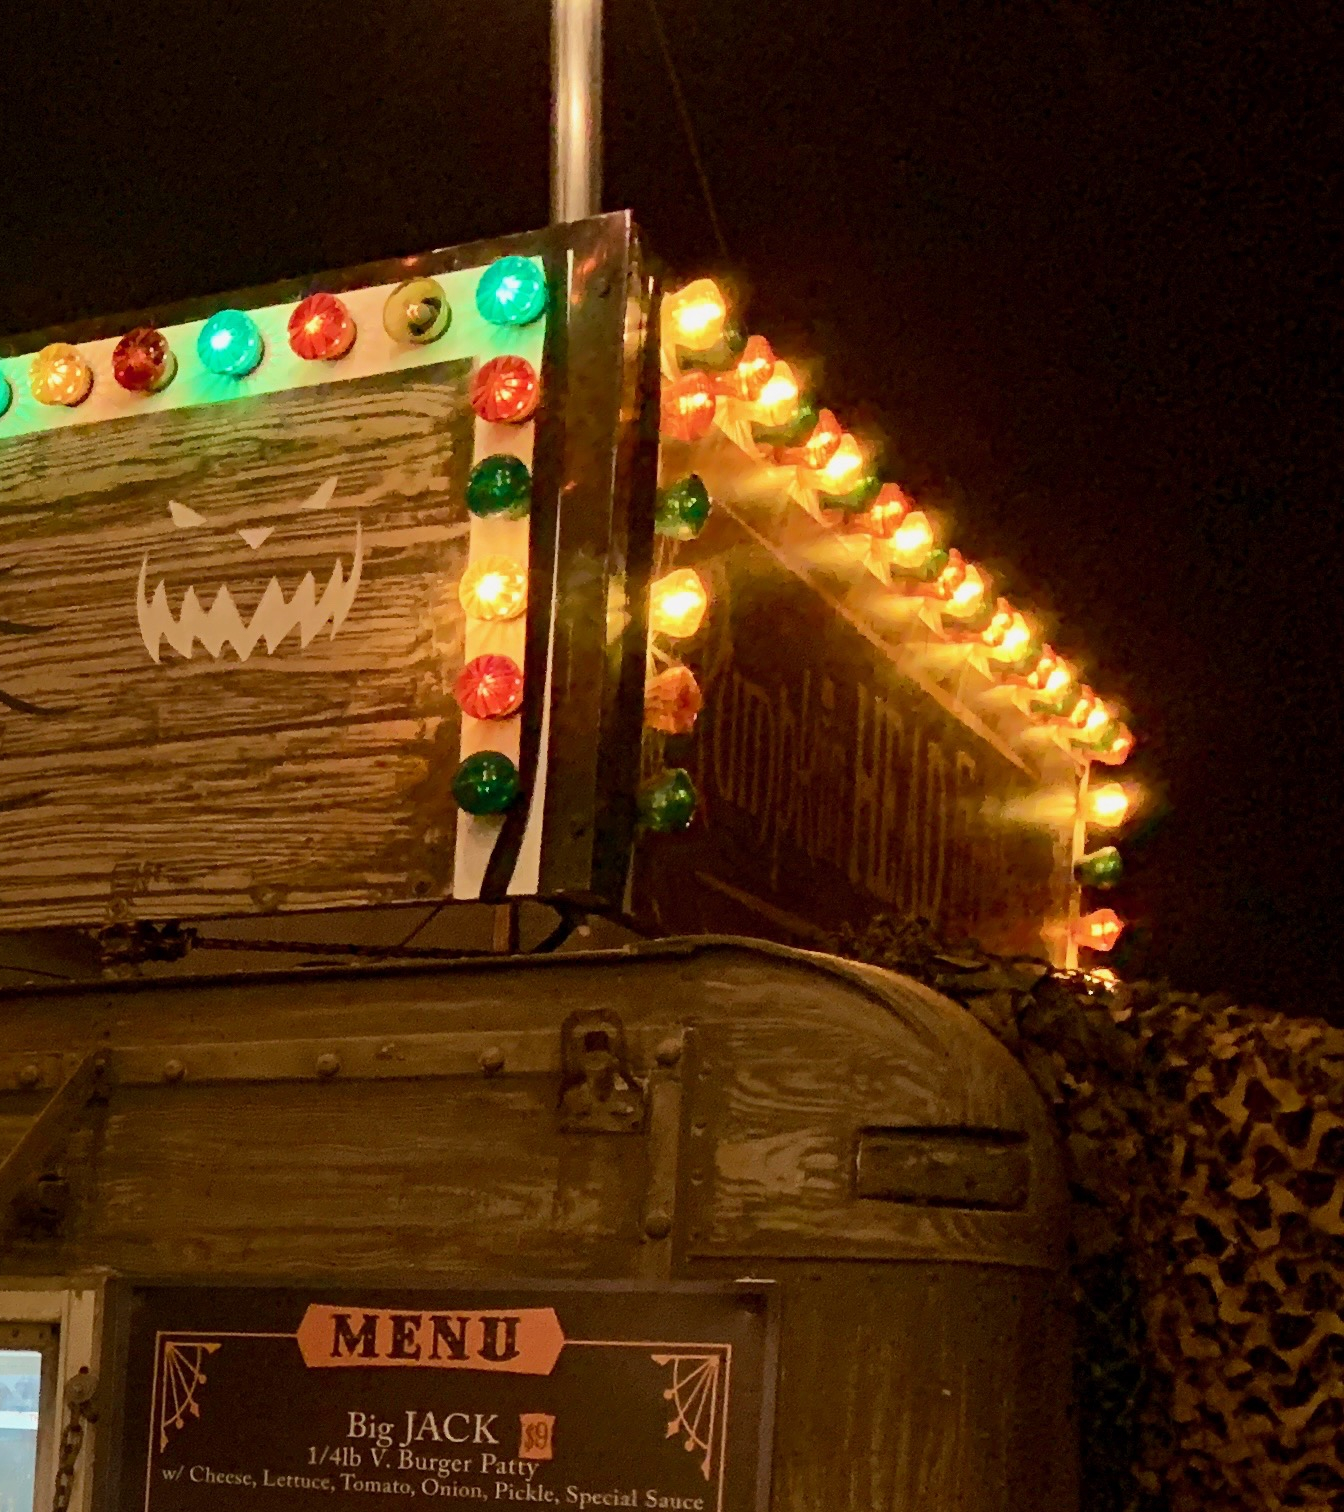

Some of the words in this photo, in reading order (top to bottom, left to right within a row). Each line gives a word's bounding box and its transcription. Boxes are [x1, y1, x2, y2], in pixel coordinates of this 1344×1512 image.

[329, 1312, 522, 1362] MENU
[347, 1412, 393, 1446] Big
[406, 1412, 500, 1445] JACK
[307, 1446, 362, 1468] 1/4lb
[370, 1449, 392, 1469] V.
[398, 1450, 473, 1475] Burger
[481, 1455, 539, 1480] Patty
[162, 1465, 183, 1482] w/
[190, 1466, 257, 1487] Cheese,
[263, 1469, 334, 1491] Lettuce,
[340, 1474, 415, 1496] Tomato,
[421, 1479, 488, 1499] Onion,
[494, 1481, 559, 1503] Pickle,
[566, 1485, 637, 1510] Special
[645, 1490, 703, 1512] Sauce
